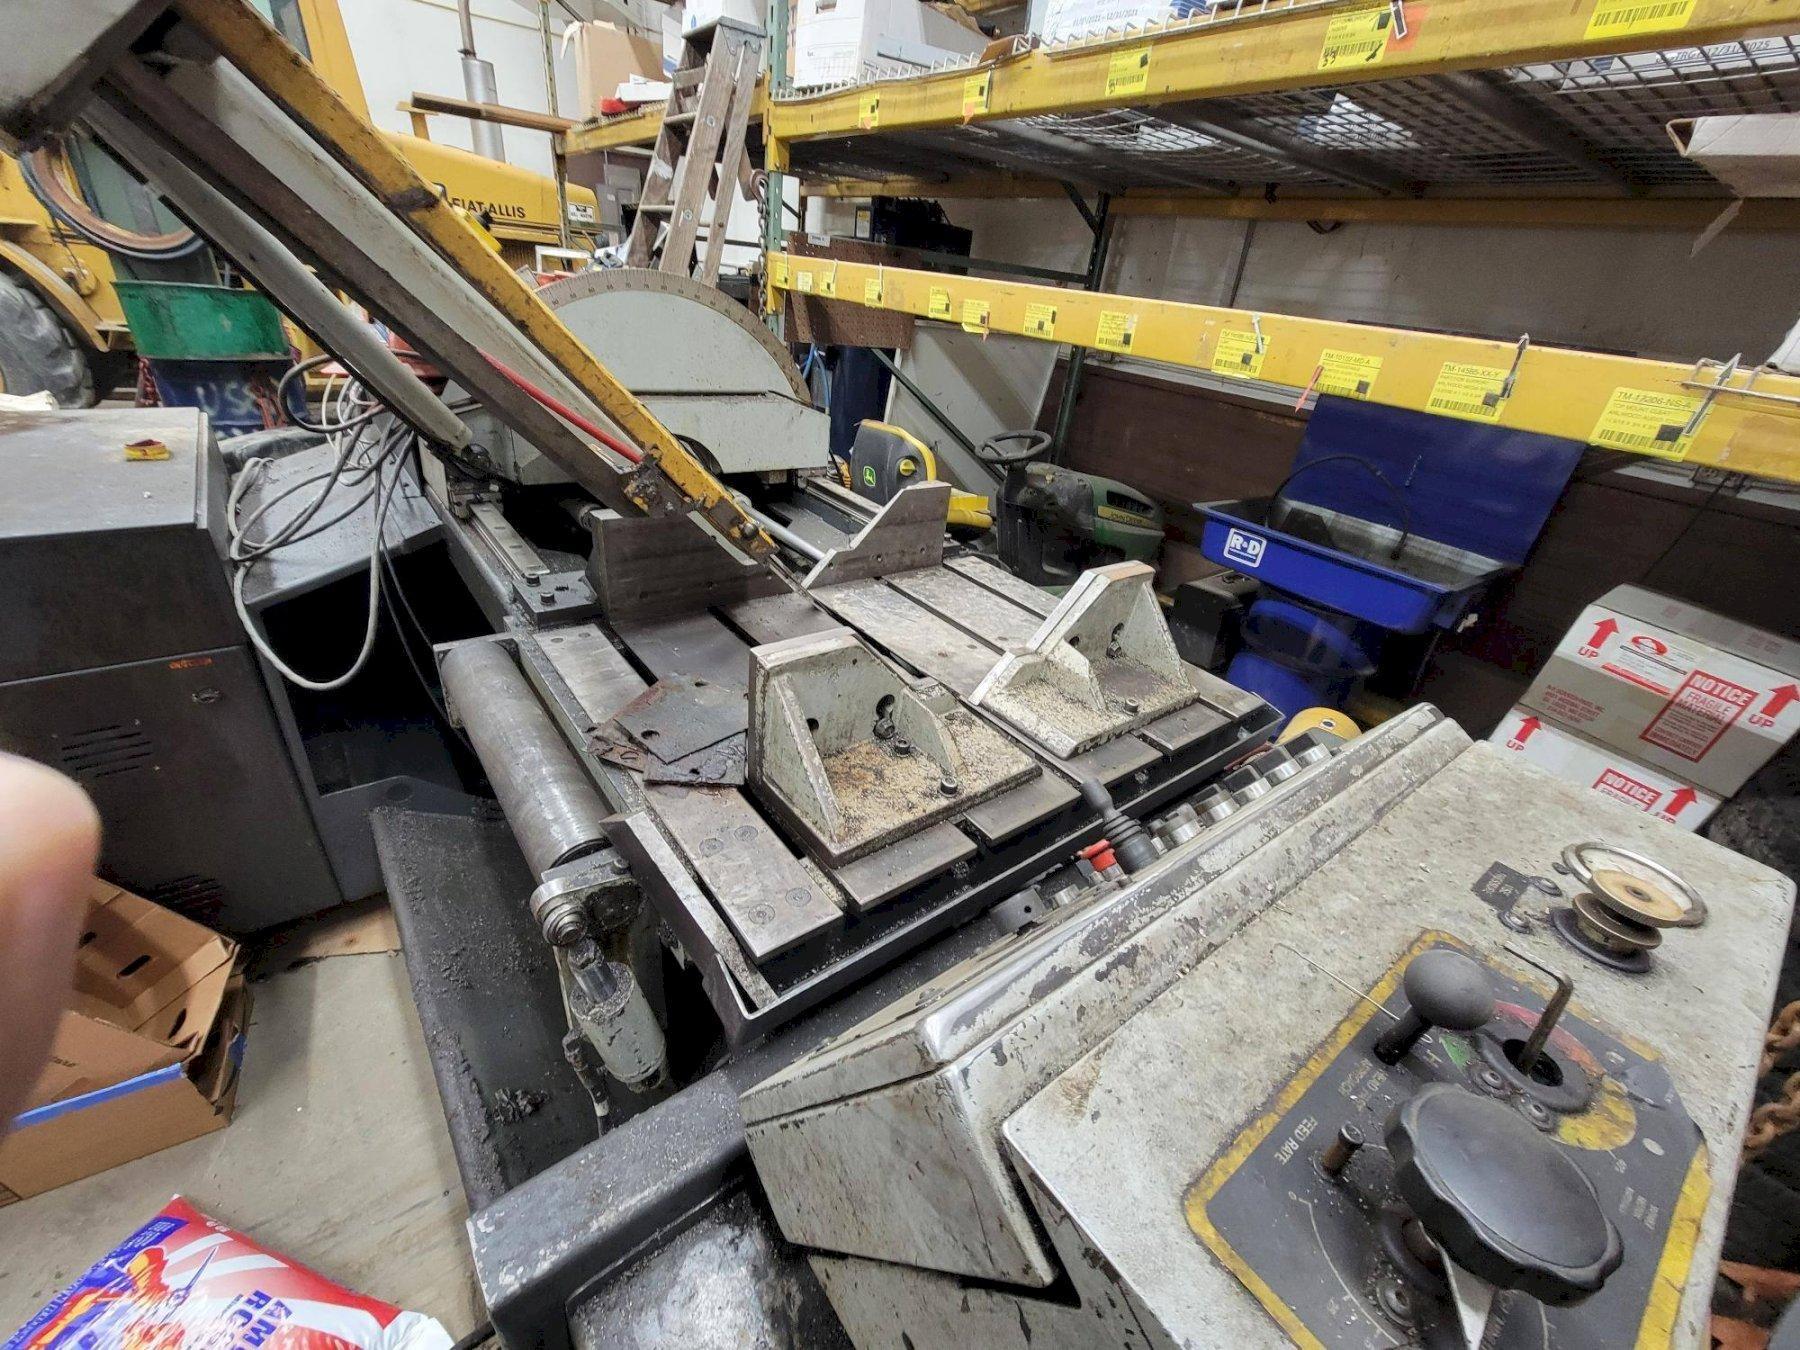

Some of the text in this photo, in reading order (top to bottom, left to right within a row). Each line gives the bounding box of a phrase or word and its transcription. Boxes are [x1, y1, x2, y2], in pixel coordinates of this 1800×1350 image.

[1578, 646, 1599, 659] UP
[1689, 674, 1753, 706] NOTICE
[1686, 691, 1733, 715] FRAGILE
[1748, 714, 1775, 728] UP
[1506, 739, 1525, 751] UP
[1603, 772, 1658, 804] NOTICE
[1274, 1116, 1318, 1165] FEED RATE
